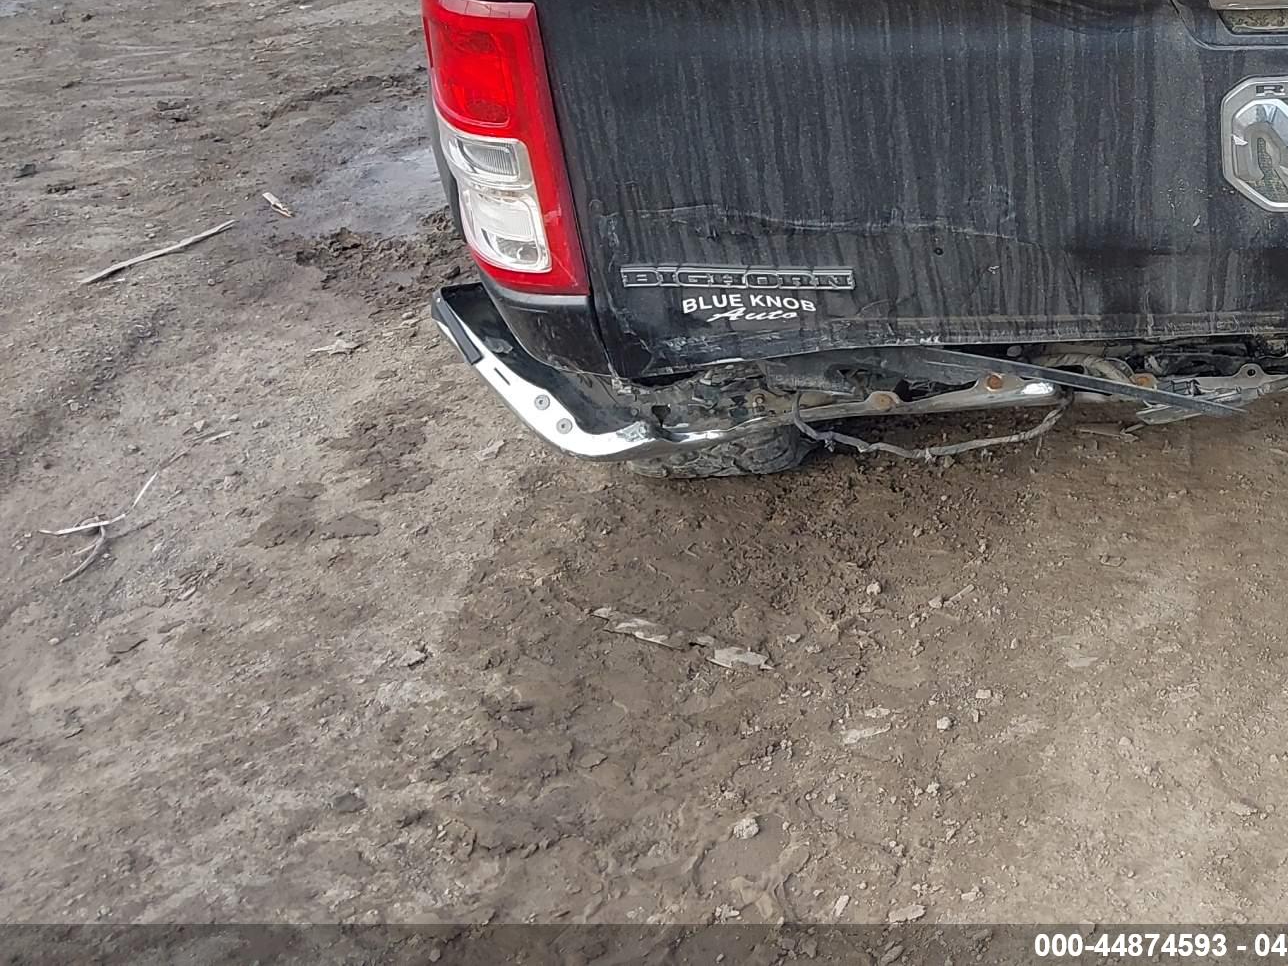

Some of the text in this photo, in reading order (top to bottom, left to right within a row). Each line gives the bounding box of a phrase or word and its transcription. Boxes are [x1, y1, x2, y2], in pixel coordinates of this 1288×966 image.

[682, 293, 817, 314] BLUE KNOB
[706, 306, 798, 323] Auto
